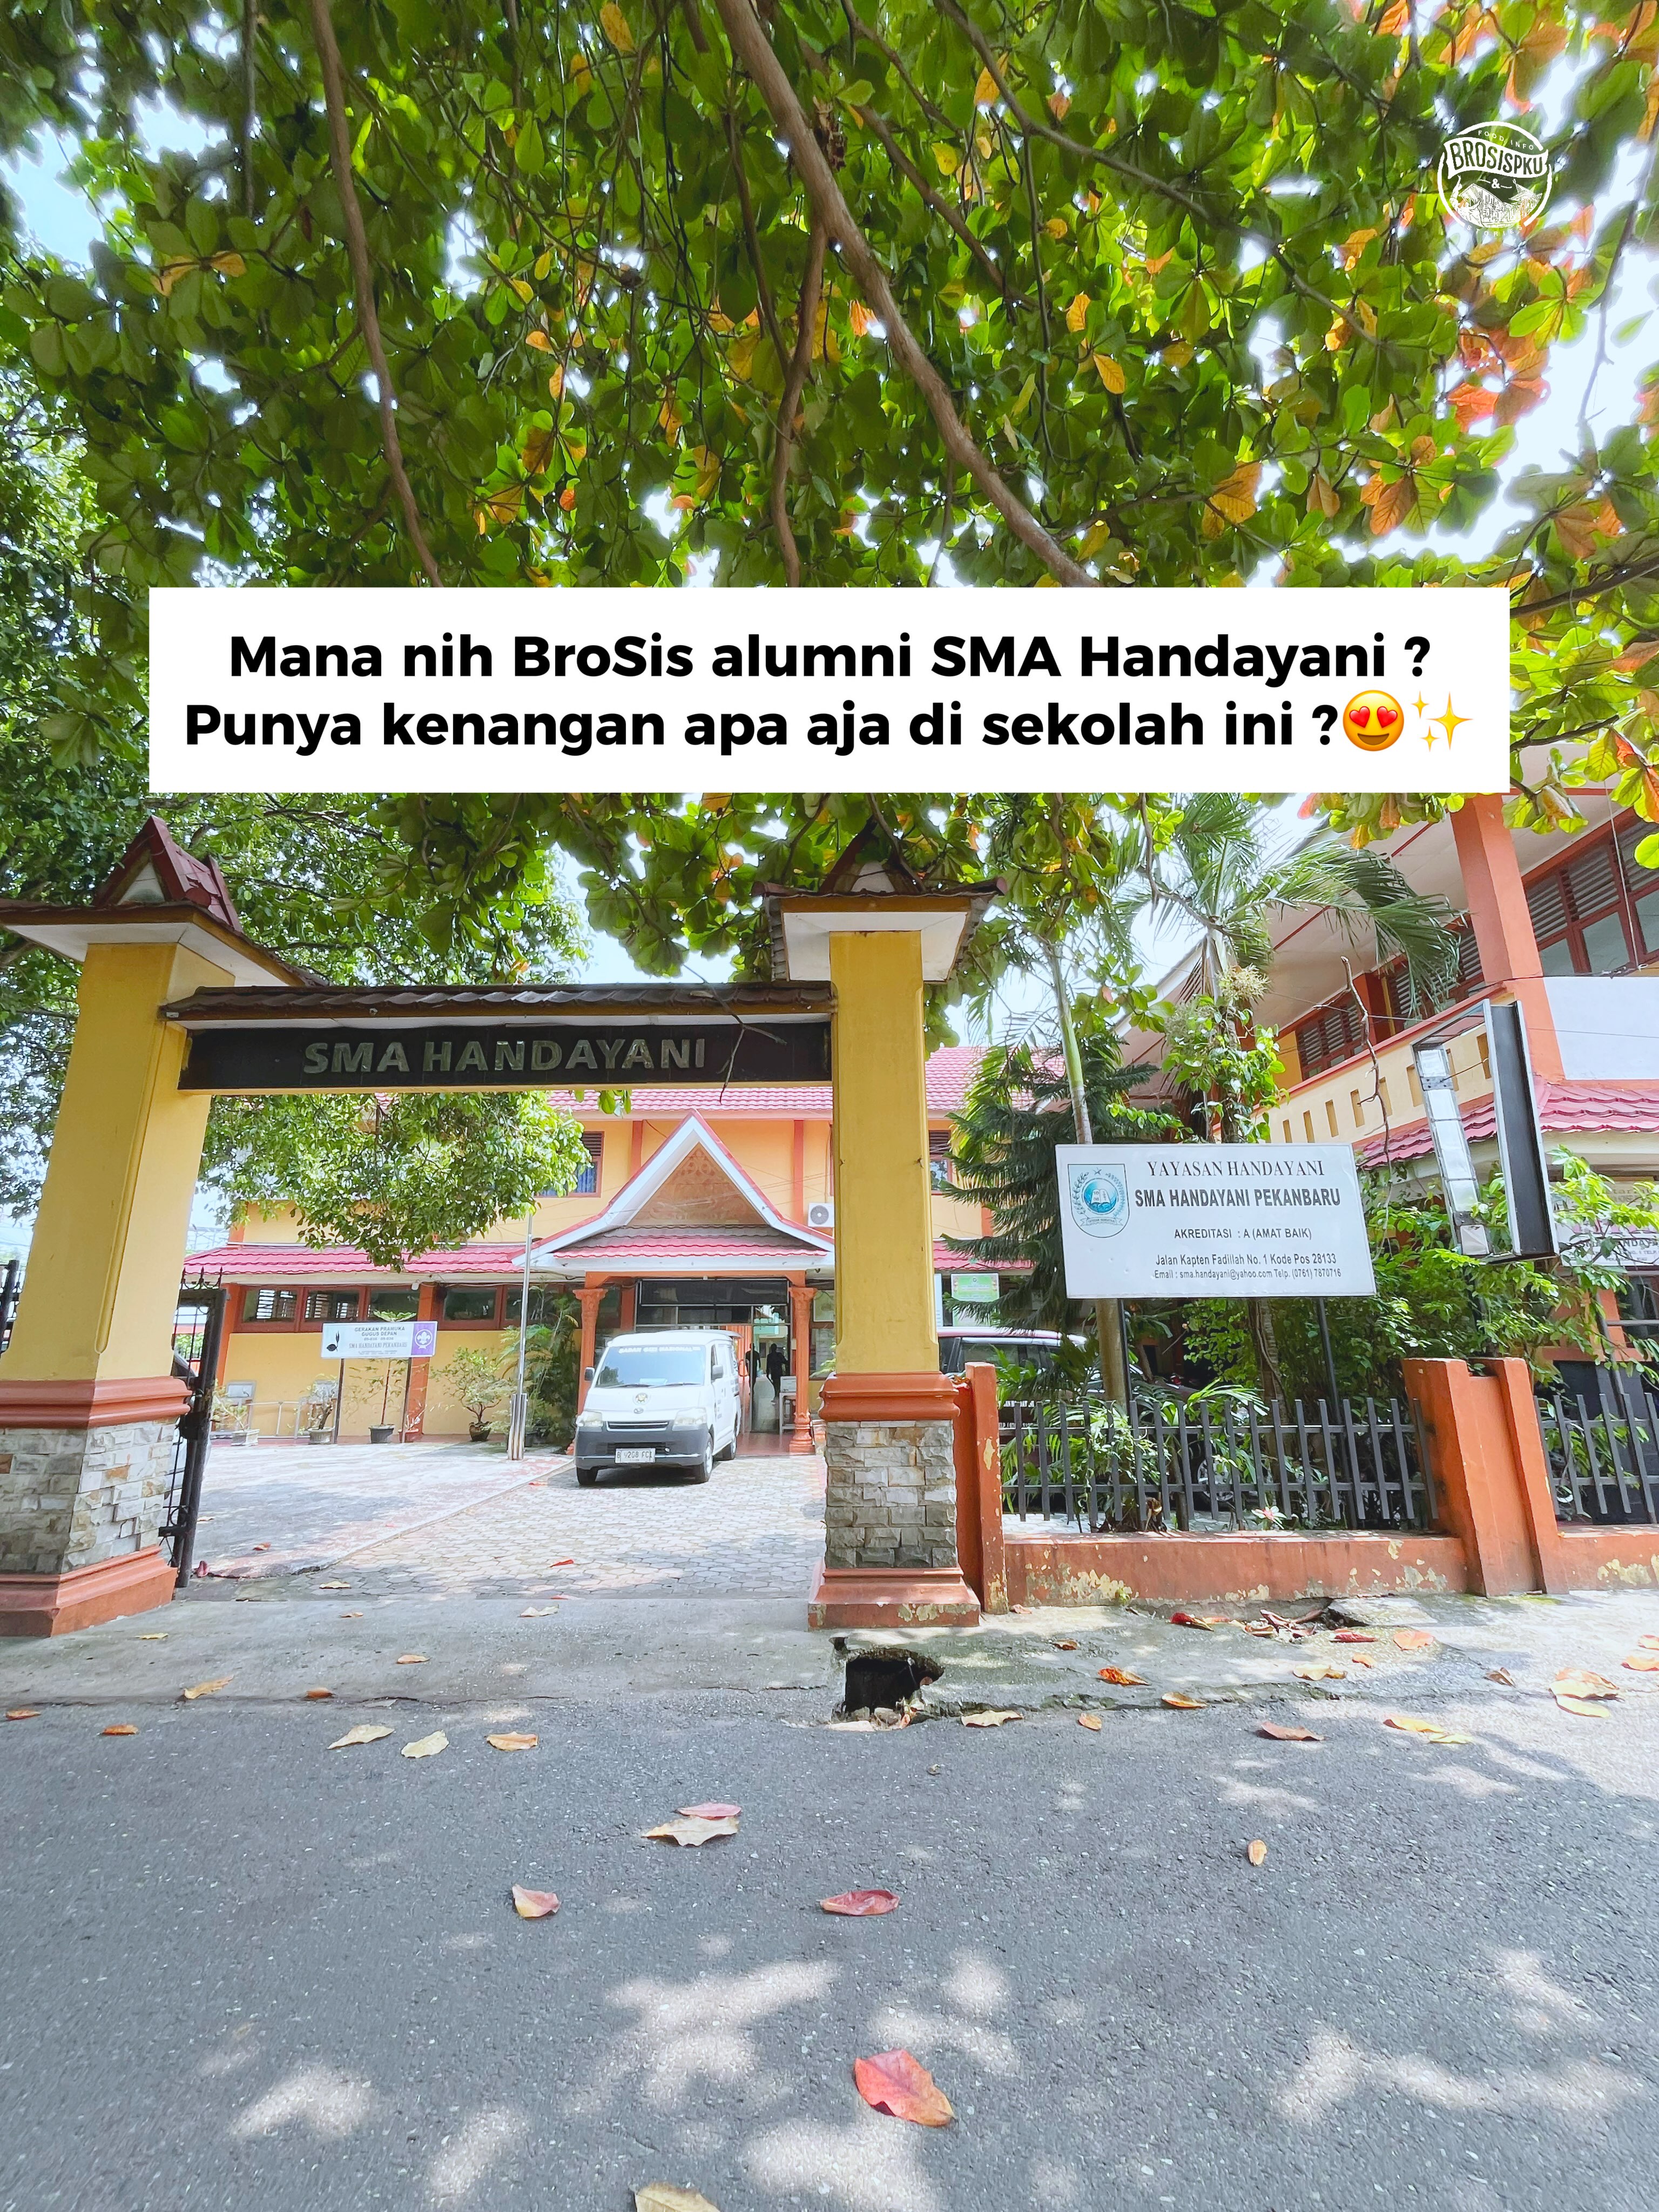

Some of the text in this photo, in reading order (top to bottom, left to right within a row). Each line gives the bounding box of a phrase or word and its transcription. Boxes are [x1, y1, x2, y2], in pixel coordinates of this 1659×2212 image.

[304, 1038, 705, 1074] SMA HANDAYANI
[1147, 1160, 1325, 1176] YAYASAN HANDAYANI
[1135, 1188, 1340, 1207] SMA HANDAYANI PEKANBARU
[1174, 1229, 1232, 1239] AKREDITASI
[1243, 1230, 1250, 1239] A
[1252, 1228, 1282, 1240] (AMAT
[1285, 1228, 1312, 1240] BAIK)
[1156, 1253, 1337, 1267] Jalan Kapten Fadillah No. 1 Kode Pos 28133
[1154, 1270, 1174, 1279] Email
[1274, 1269, 1291, 1279] Telp.
[1292, 1269, 1313, 1280] (0761)
[1314, 1269, 1341, 1278] 7870716
